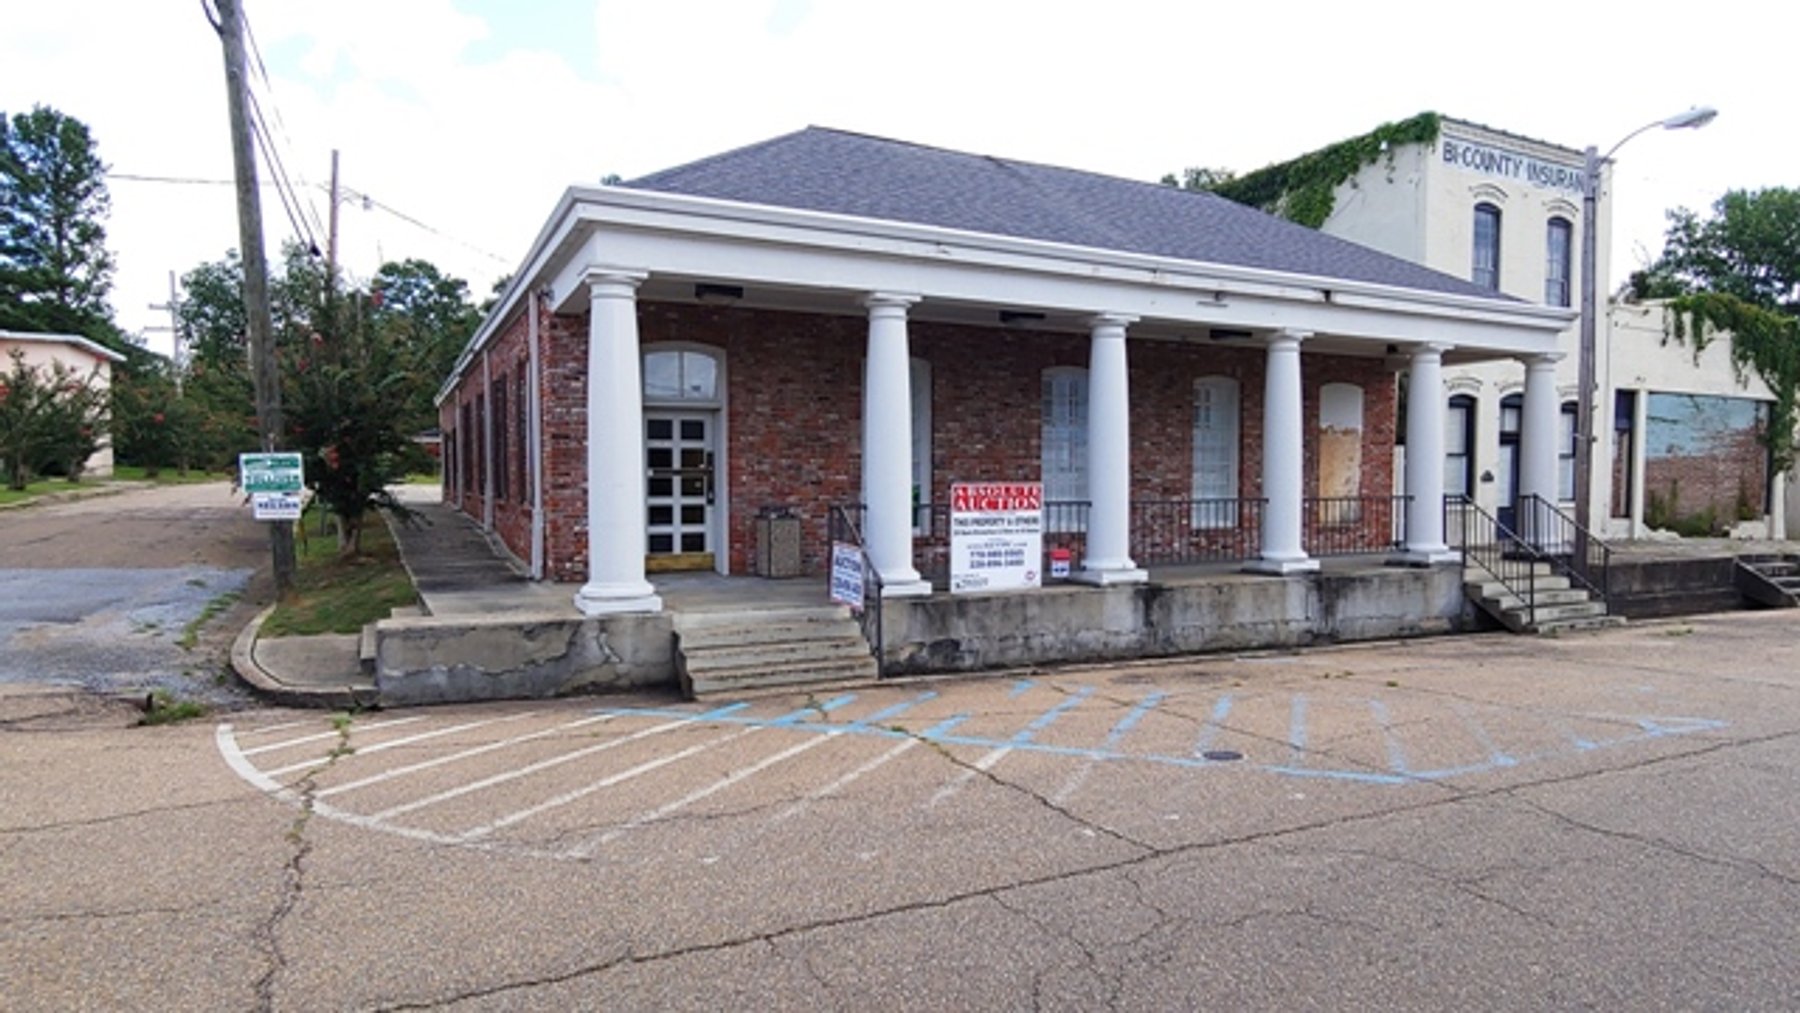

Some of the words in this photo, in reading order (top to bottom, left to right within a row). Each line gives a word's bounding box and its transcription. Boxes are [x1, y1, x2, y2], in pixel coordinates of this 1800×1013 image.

[1443, 141, 1523, 178] BI-COUNTY
[1527, 162, 1586, 193] INSURAN
[954, 485, 1041, 497] ABSOLUTE
[954, 497, 1041, 511] AUCTION
